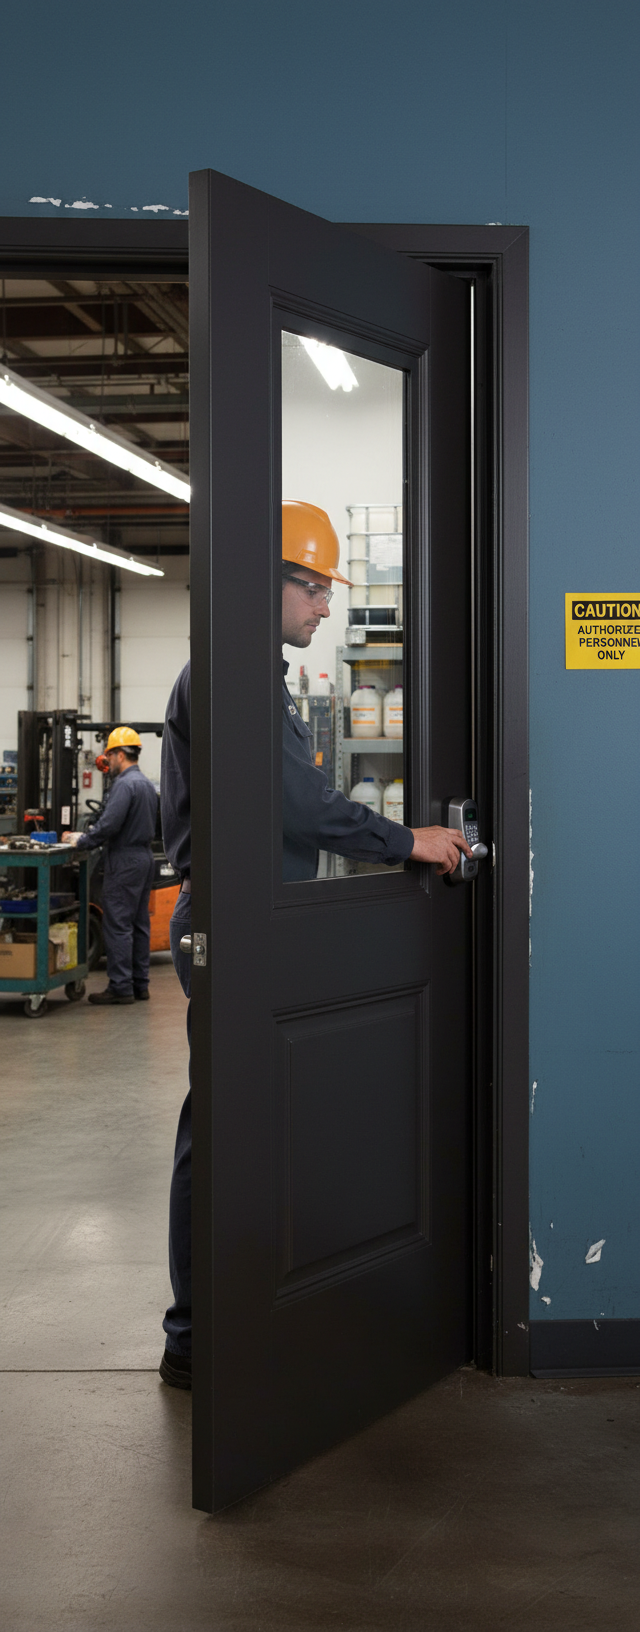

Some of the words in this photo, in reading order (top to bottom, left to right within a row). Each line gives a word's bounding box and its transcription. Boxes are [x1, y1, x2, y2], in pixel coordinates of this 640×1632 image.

[574, 603, 640, 617] CAUTION
[579, 637, 640, 647] PERSONNE
[597, 650, 626, 660] ONLY
